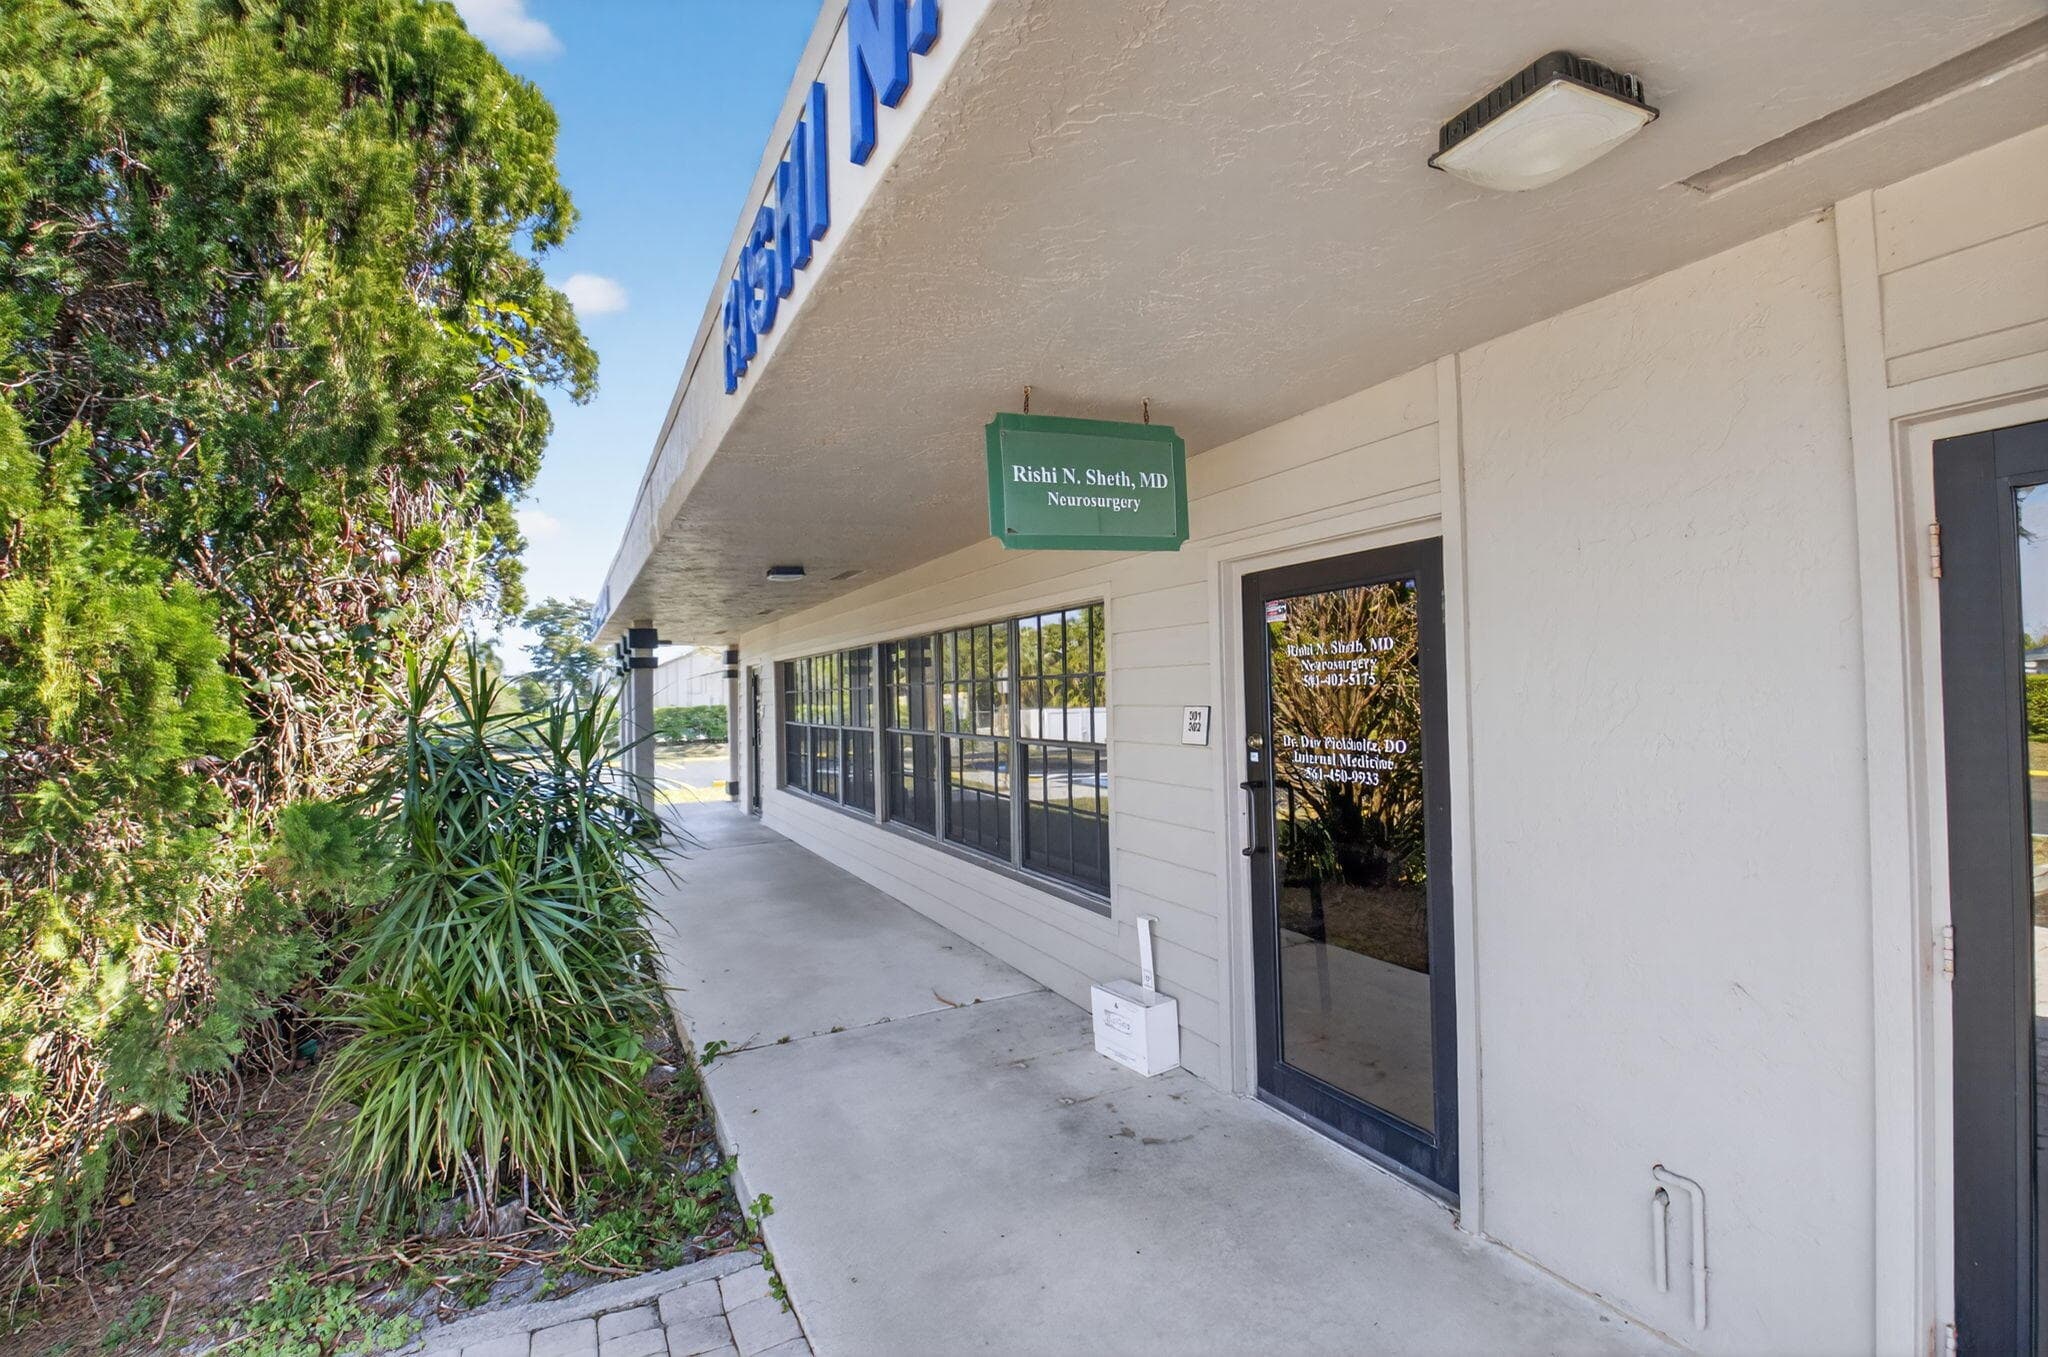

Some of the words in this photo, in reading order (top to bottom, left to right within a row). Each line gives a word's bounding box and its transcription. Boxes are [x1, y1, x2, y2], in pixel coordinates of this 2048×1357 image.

[722, 82, 828, 394] RISHI
[1012, 465, 1057, 484] Rishi
[1062, 468, 1080, 485] N.
[1086, 469, 1135, 490] Sheth,
[1140, 472, 1168, 489] MD
[1047, 492, 1141, 512] Neurosurgery
[1316, 642, 1328, 656] N.
[1370, 637, 1394, 652] MD
[1301, 659, 1377, 675] Neurosurgery
[1189, 711, 1201, 721] 301
[1188, 722, 1201, 732] 302
[1283, 735, 1299, 747] Dr.
[1384, 739, 1407, 754] DO
[1292, 750, 1336, 766] Internal
[1339, 753, 1395, 770] Medicine
